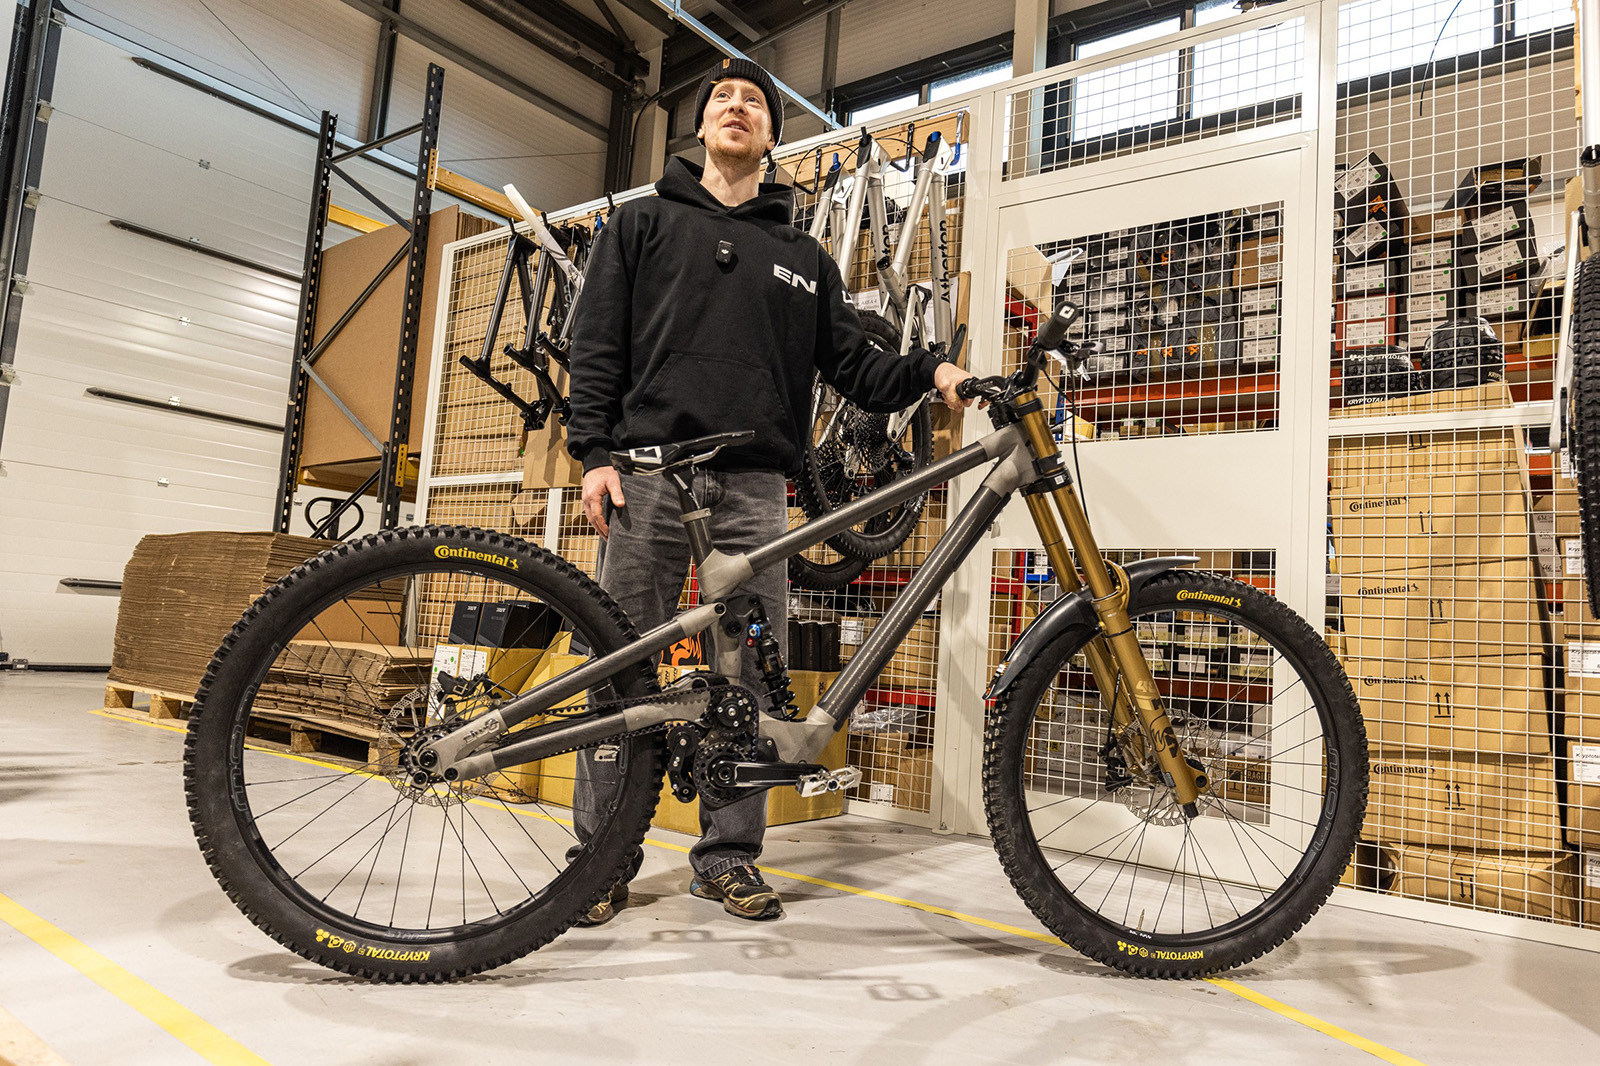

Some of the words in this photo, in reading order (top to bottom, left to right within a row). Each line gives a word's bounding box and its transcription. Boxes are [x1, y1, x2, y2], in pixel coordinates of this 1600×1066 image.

[773, 263, 818, 296] EN
[433, 545, 509, 567] Continental
[1176, 589, 1234, 606] Continental
[1364, 675, 1417, 686] Coninental
[366, 946, 431, 961] KRYPTOTAL
[1156, 950, 1204, 961] KRYPTOTAL
